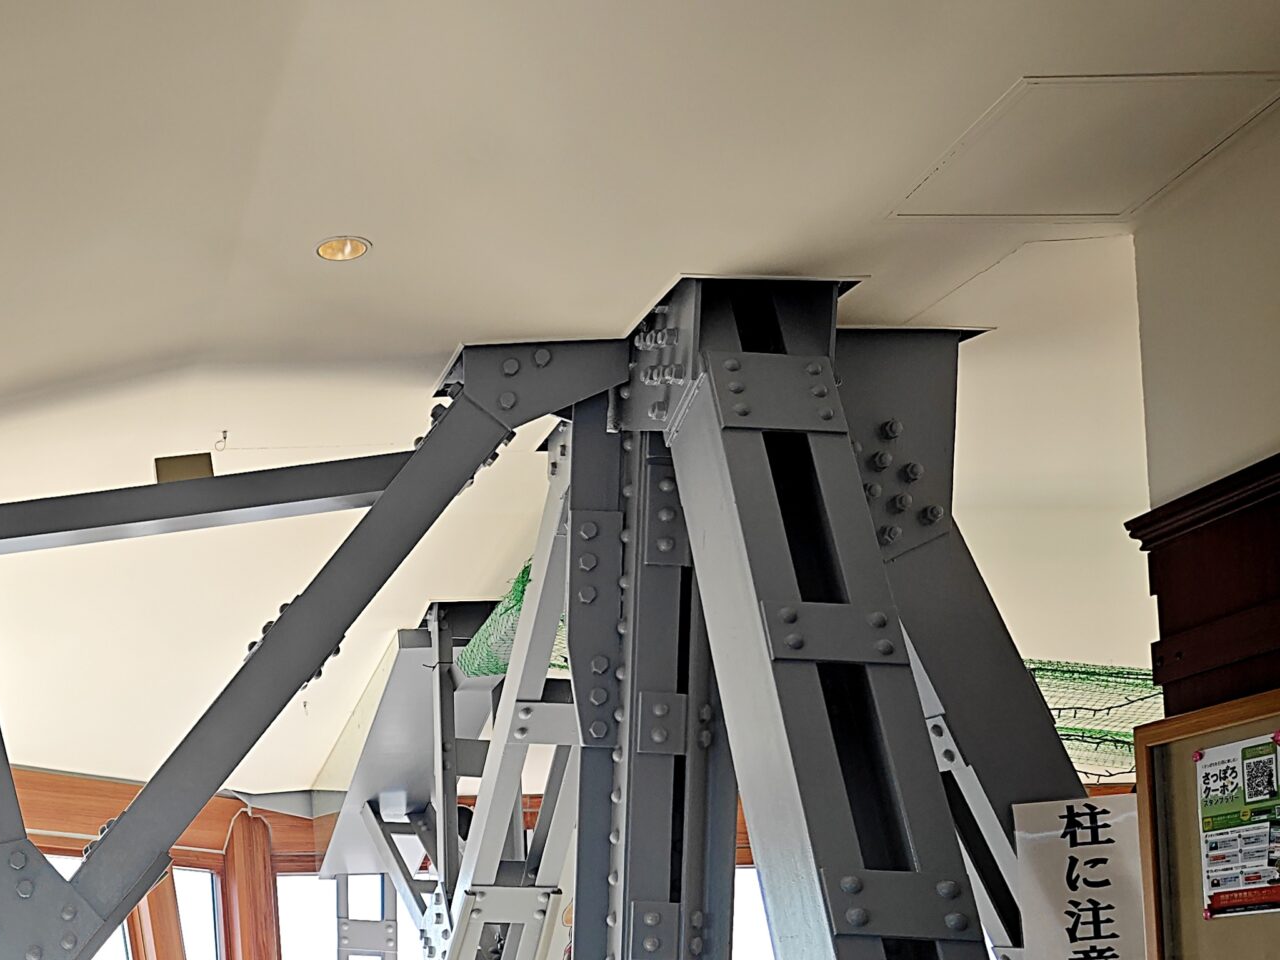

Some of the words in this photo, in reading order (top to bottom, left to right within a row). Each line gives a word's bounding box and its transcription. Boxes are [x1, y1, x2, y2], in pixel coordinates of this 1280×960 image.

[1202, 765, 1238, 785] さっぽろ
[1203, 781, 1239, 799] クーポン
